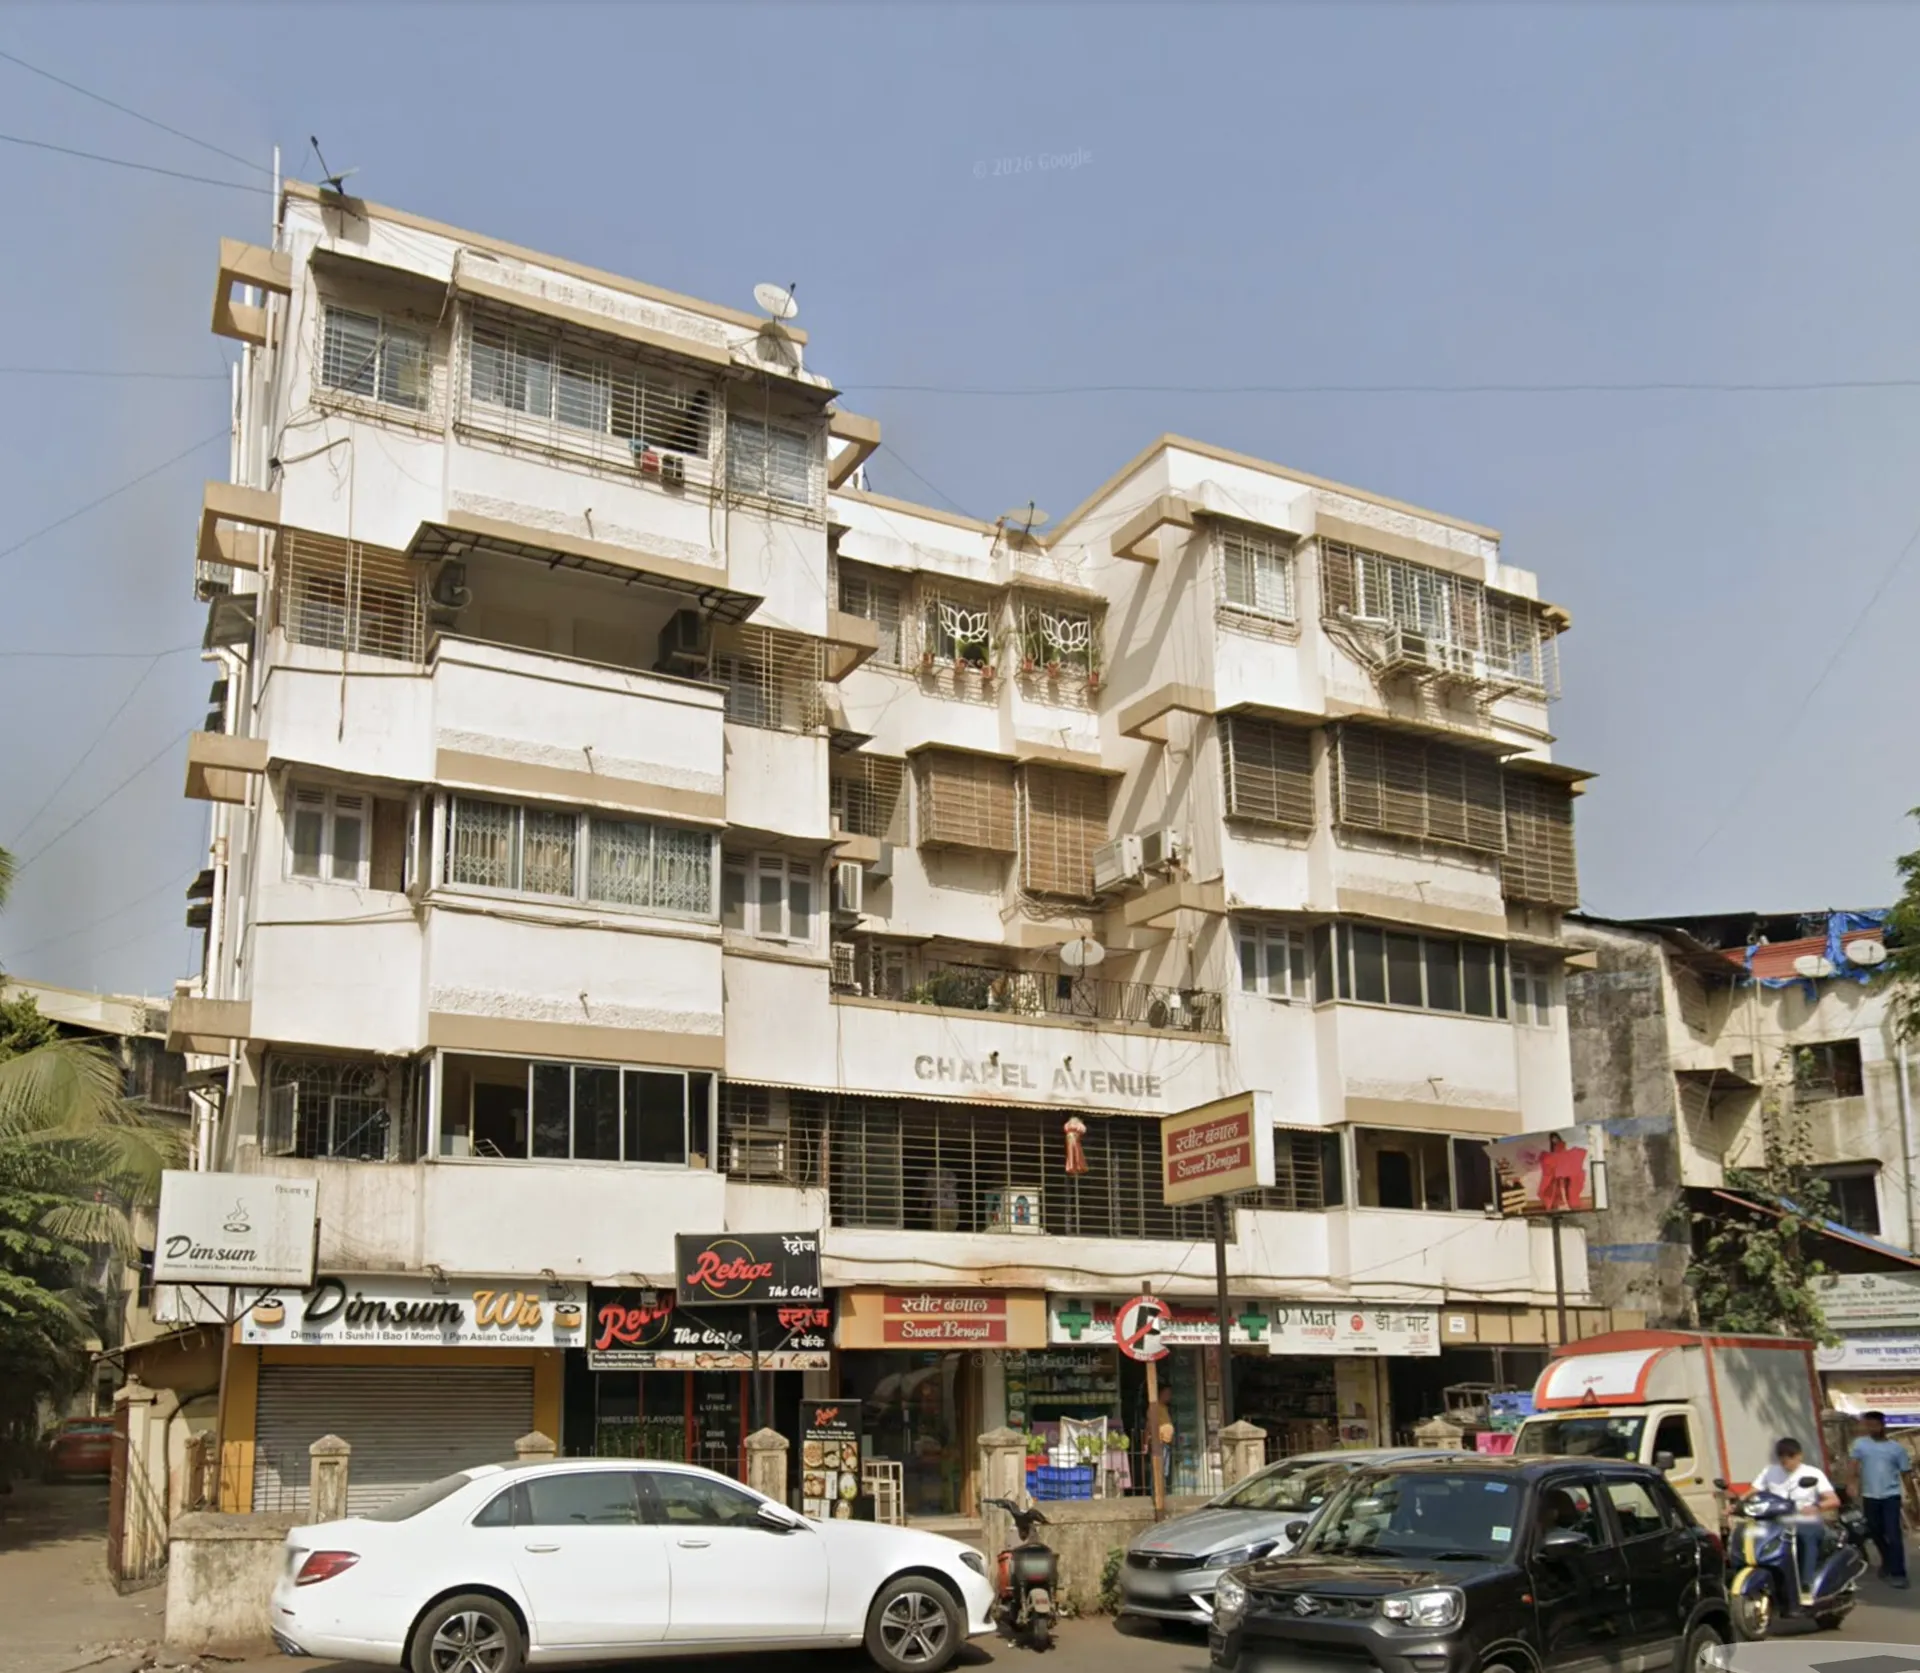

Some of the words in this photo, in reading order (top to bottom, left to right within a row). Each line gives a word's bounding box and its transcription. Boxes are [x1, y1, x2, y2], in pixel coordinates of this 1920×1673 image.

[914, 1055, 1037, 1089] CHAPEL
[1052, 1068, 1162, 1098] AVENUE
[1176, 1128, 1204, 1152] स्वीट
[1205, 1122, 1239, 1144] बंगाल
[1177, 1160, 1205, 1178] Sweet
[1204, 1147, 1241, 1171] Bengal
[165, 1235, 257, 1262] Dimsum
[687, 1250, 773, 1288] Retroz
[302, 1276, 465, 1325] Dimsum
[768, 1286, 787, 1297] The
[791, 1285, 819, 1298] Cafe
[902, 1293, 941, 1313] स्वीट
[944, 1293, 988, 1313] बंगाल
[1299, 1308, 1337, 1326] Mart
[290, 1330, 334, 1340] Dimsum
[345, 1331, 374, 1340] Sushi
[382, 1332, 402, 1340] Bao
[411, 1332, 441, 1341] Momo
[449, 1332, 468, 1341] Pan
[469, 1333, 497, 1341] Asian
[499, 1333, 535, 1342] Cuisine
[673, 1328, 698, 1345] The
[902, 1321, 942, 1338] Sweet
[943, 1321, 990, 1340] Bengal
